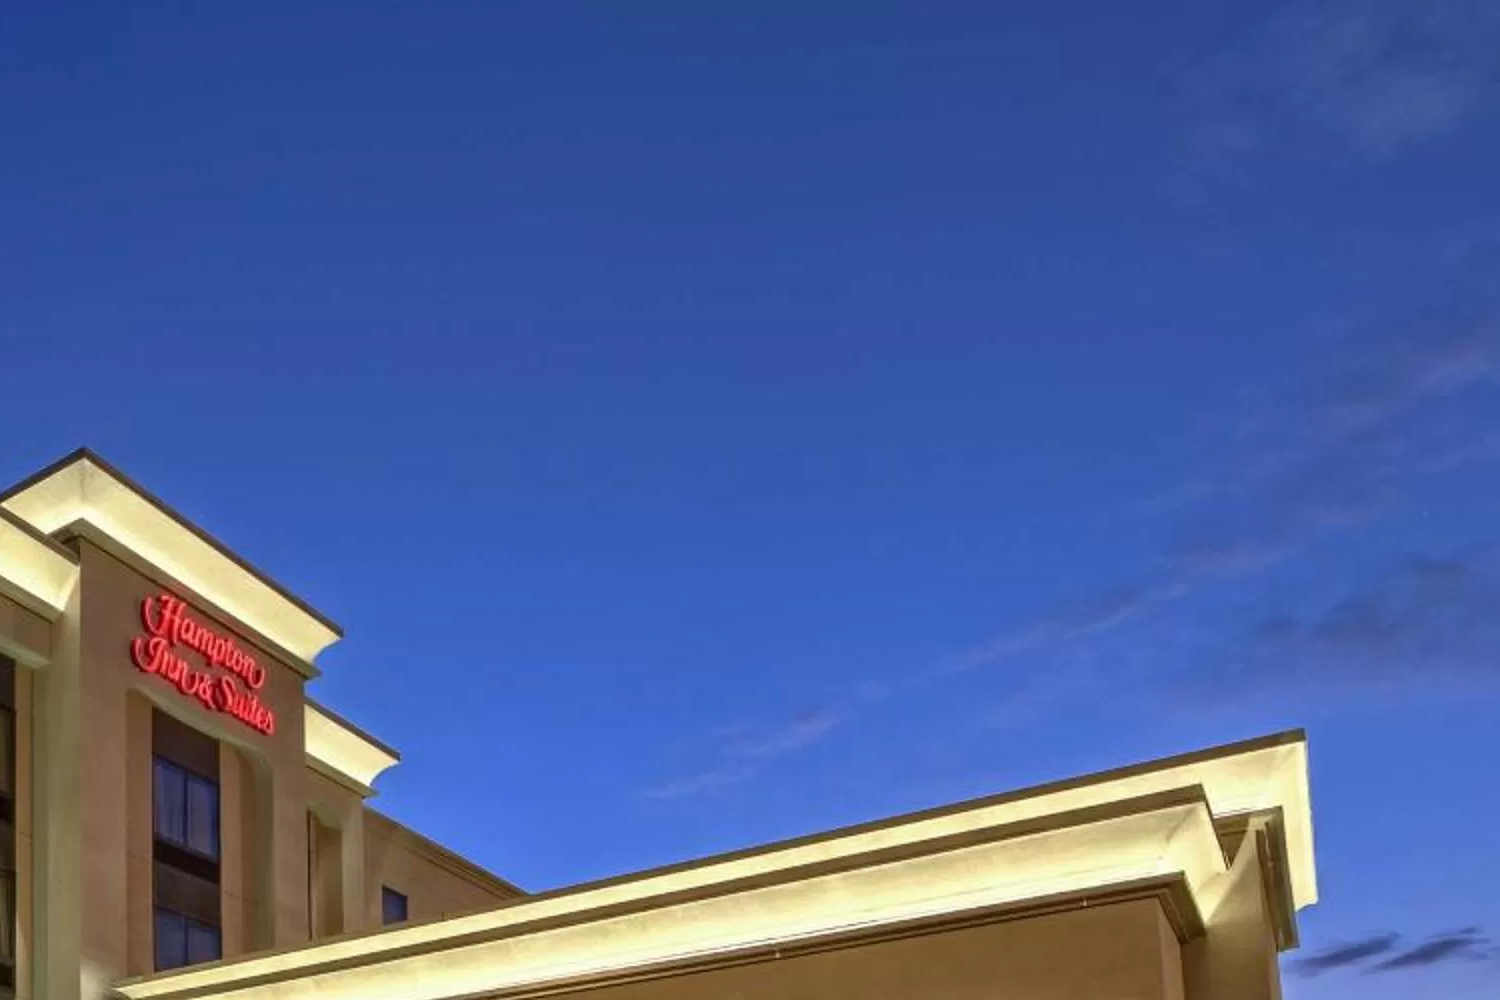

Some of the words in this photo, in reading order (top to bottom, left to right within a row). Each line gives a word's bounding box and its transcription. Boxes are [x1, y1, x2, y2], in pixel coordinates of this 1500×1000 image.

[131, 636, 199, 695] Inn
[200, 674, 217, 710] &
[216, 675, 276, 736] Suites
[141, 594, 266, 689] Hampton
